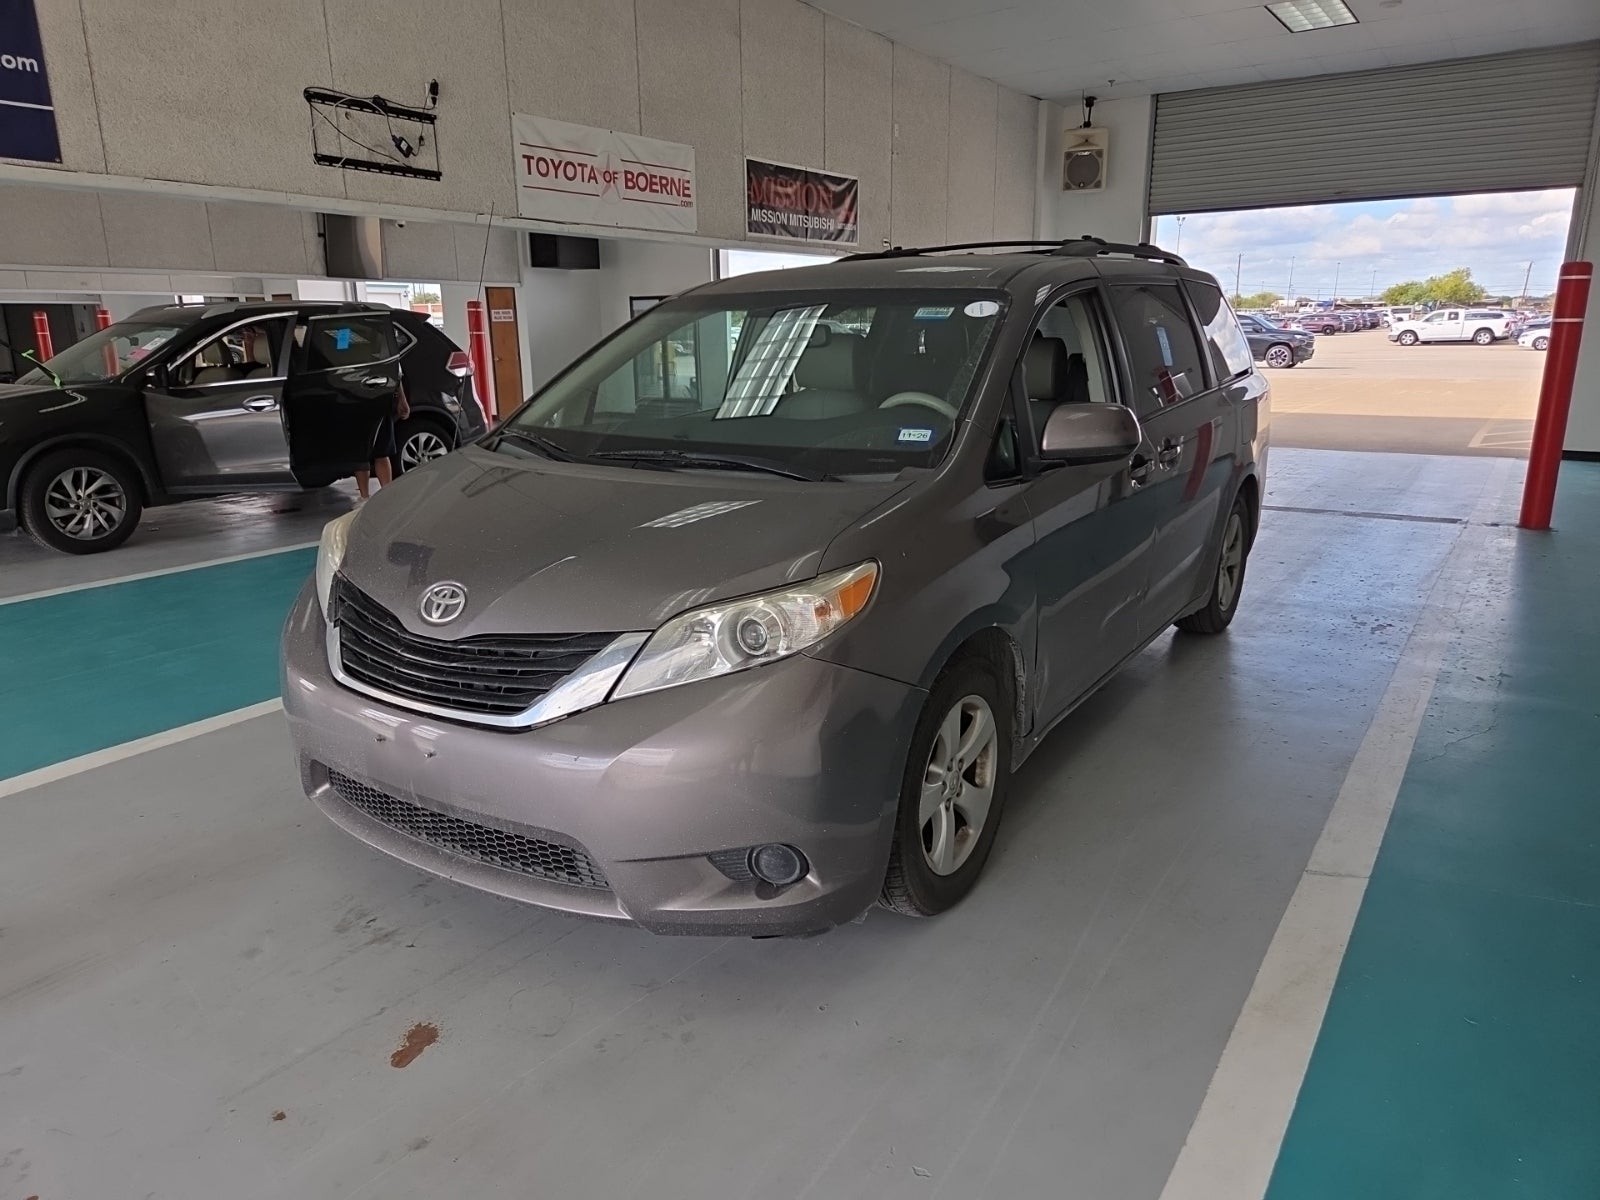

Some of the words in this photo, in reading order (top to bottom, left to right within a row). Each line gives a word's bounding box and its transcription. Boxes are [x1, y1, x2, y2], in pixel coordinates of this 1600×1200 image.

[0, 54, 39, 73] om
[522, 154, 599, 185] TOYOTA
[602, 169, 619, 185] OF
[624, 169, 692, 199] BOERNE
[749, 175, 834, 214] MISSION
[751, 208, 788, 226] MISSION
[789, 213, 835, 232] MITSUBISHI
